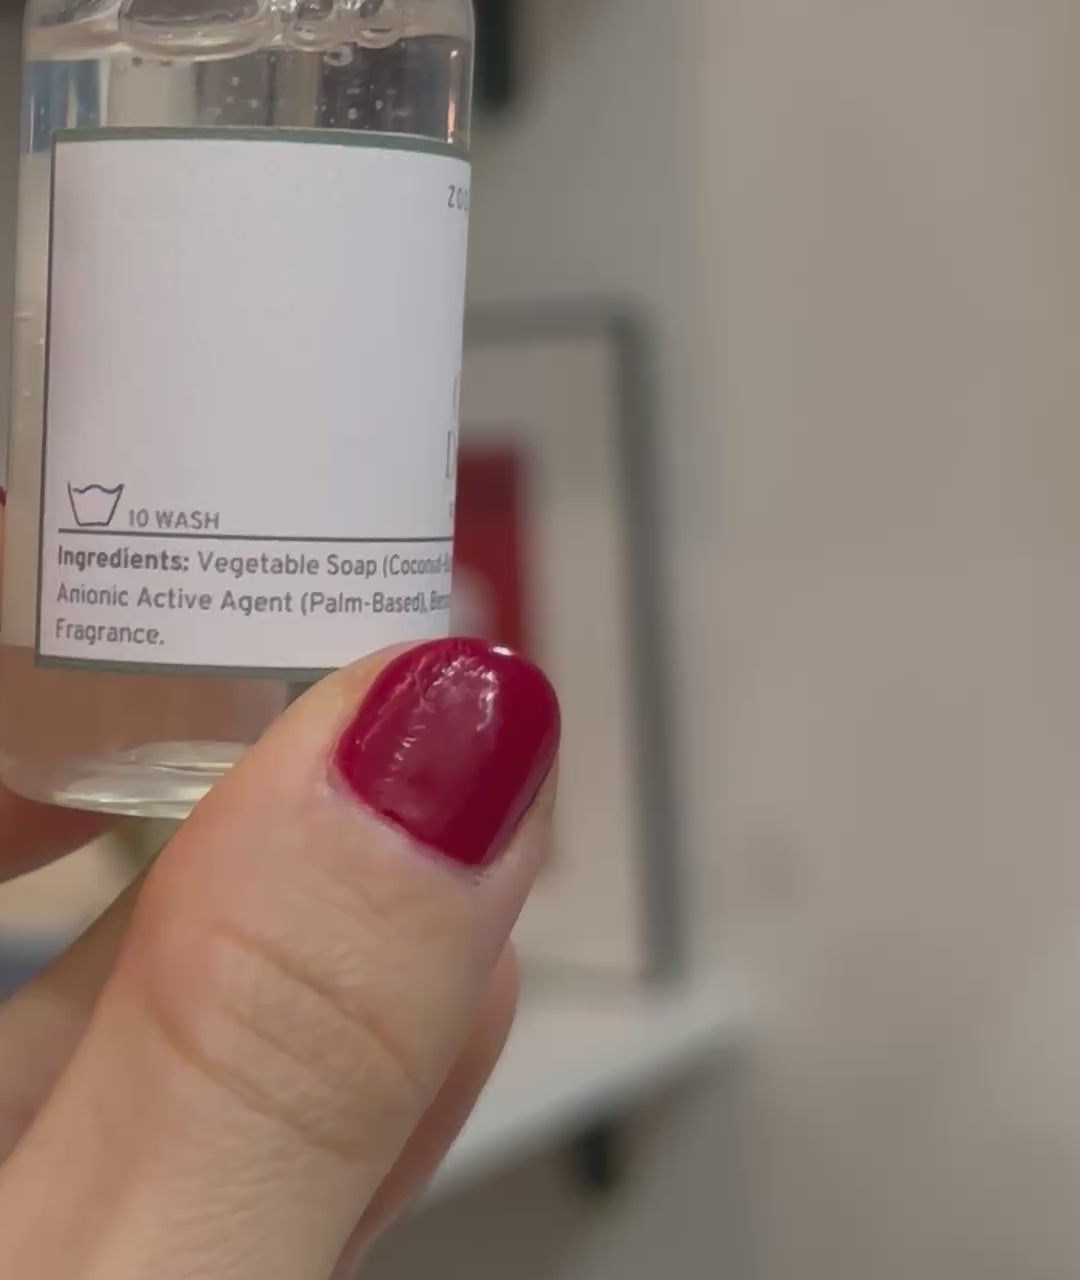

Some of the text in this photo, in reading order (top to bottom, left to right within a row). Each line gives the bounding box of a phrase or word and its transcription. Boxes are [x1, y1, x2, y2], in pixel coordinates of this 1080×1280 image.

[129, 508, 220, 530] 10 WASH
[58, 544, 190, 572] Ingredients:
[197, 550, 320, 579] Vegetable
[326, 553, 378, 580] Soap
[56, 581, 129, 607] Anionic
[137, 586, 213, 611] Active
[220, 590, 293, 617] Agent
[56, 617, 166, 646] Fragrance.
